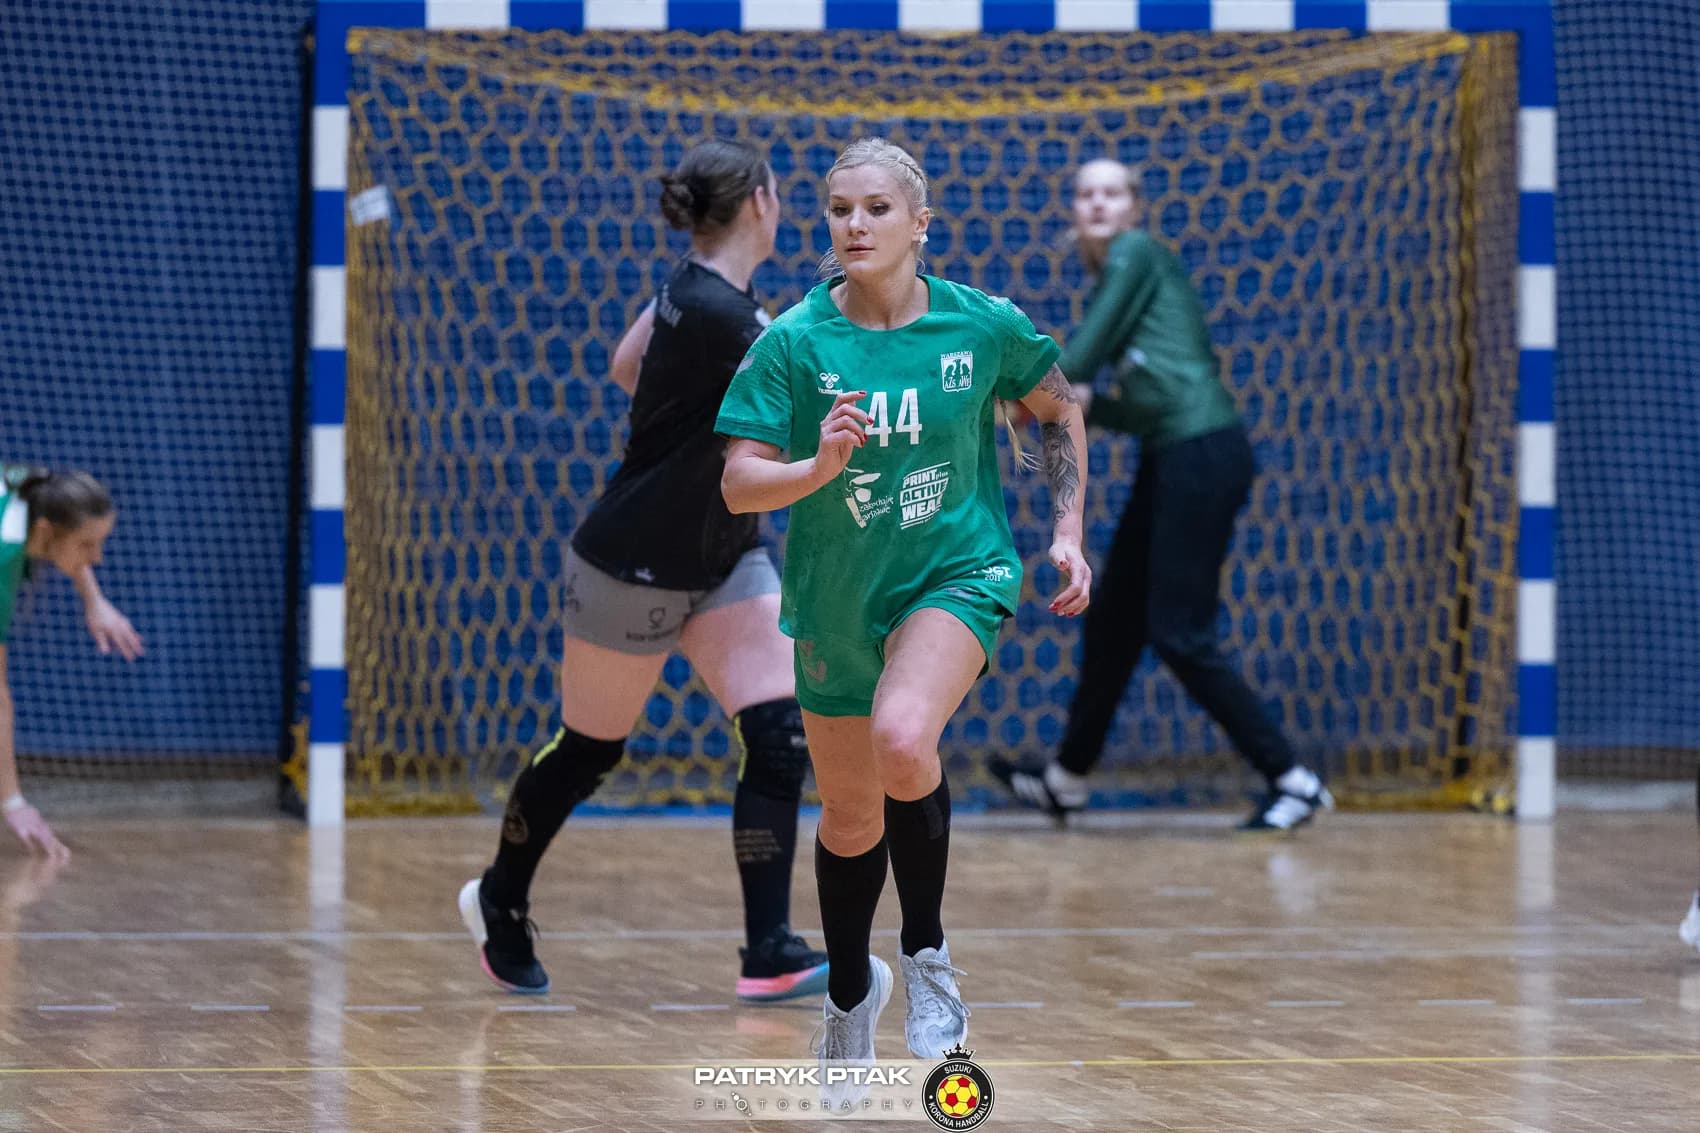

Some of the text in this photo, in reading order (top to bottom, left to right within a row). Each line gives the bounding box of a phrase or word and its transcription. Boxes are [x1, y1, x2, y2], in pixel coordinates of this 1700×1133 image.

[944, 376, 957, 389] AZS
[865, 388, 923, 448] 44
[903, 469, 938, 489] PRINT
[902, 481, 948, 504] ACTIVE
